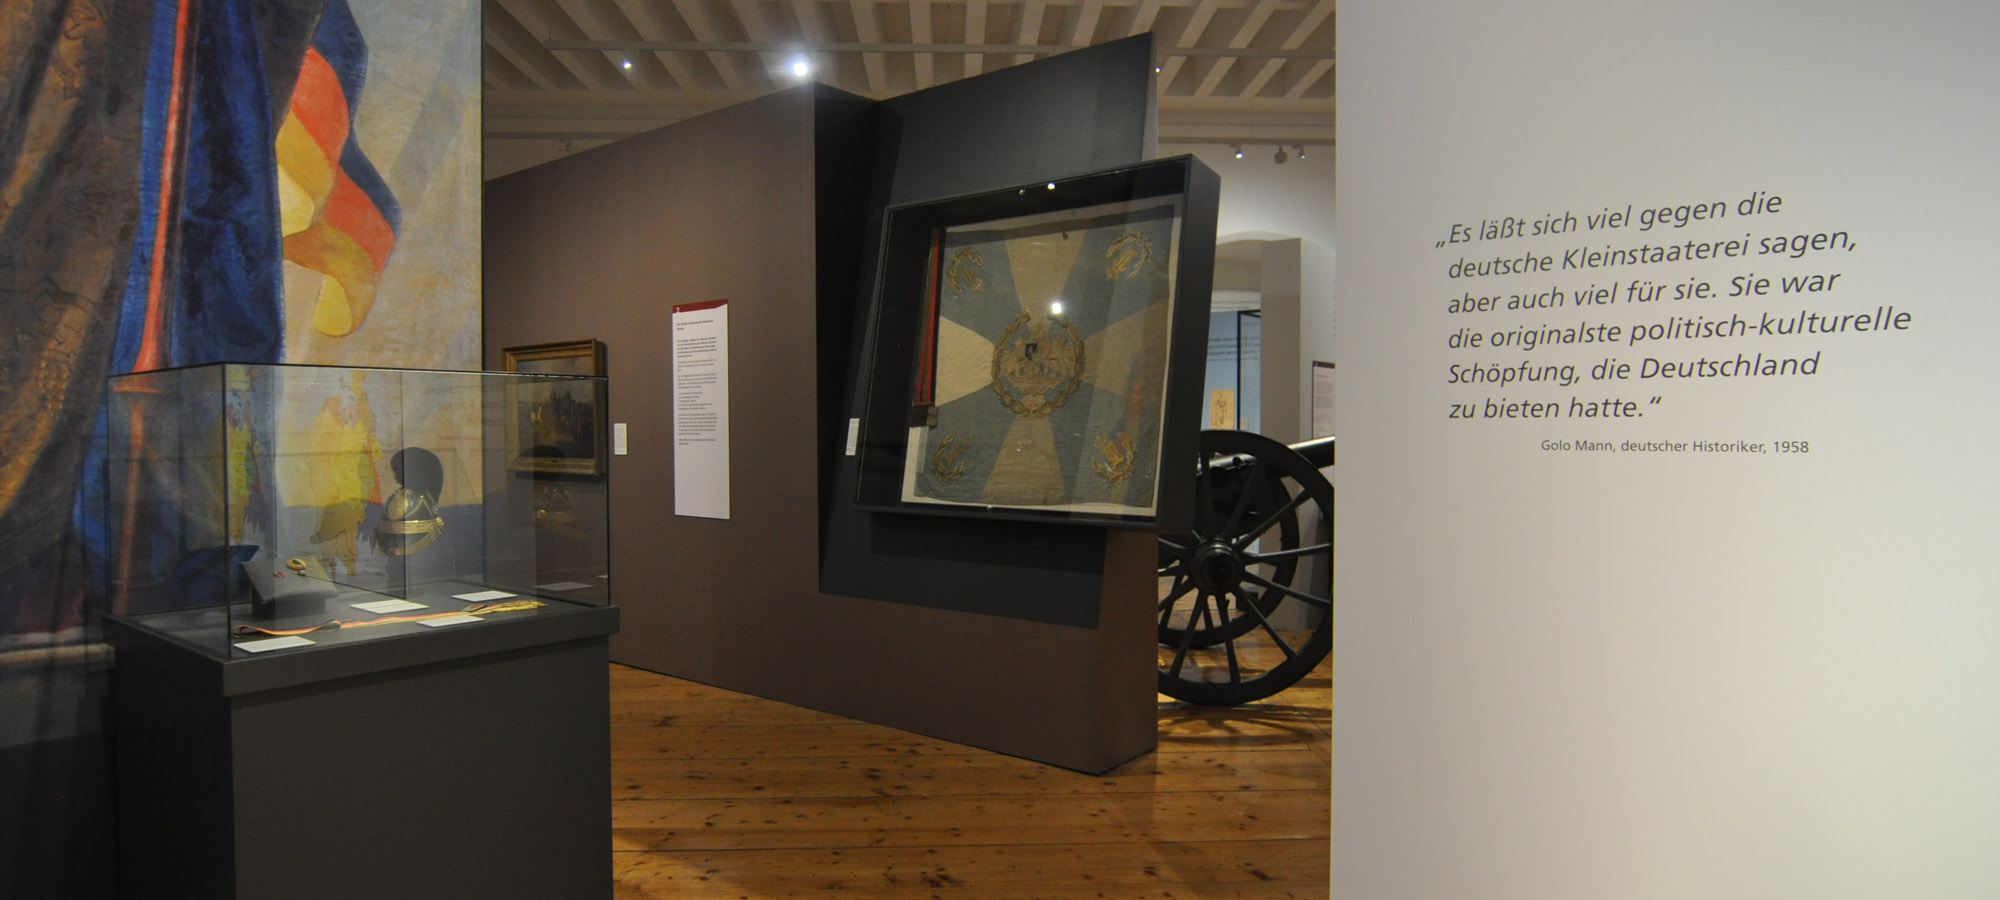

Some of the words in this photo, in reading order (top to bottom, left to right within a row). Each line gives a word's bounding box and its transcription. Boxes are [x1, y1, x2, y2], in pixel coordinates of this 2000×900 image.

[1479, 216, 1527, 241] läßt
[1531, 210, 1578, 237] sich
[1586, 204, 1632, 231] viel
[1639, 201, 1727, 232] gegen
[1737, 190, 1783, 217] die
[1448, 251, 1554, 279] deutsche
[1561, 232, 1752, 271] Kleinstaaterei
[1757, 231, 1857, 259] sagen,
[1447, 291, 1502, 314] aber
[1506, 285, 1565, 311] auch
[1574, 281, 1619, 307] viel
[1626, 279, 1668, 304] für
[1672, 276, 1717, 301] sie.
[1728, 272, 1771, 298] Sie
[1781, 273, 1842, 294] war
[1448, 327, 1483, 350] die
[1490, 320, 1622, 352] originalste
[1628, 305, 1912, 348] politisch-kulturelle
[1447, 360, 1581, 389] Schöpfung,
[1591, 357, 1631, 381] die
[1639, 350, 1822, 380] Deutschland
[1448, 403, 1477, 419] zu
[1483, 397, 1560, 419] bieten
[1540, 439, 1572, 452] Golo
[1575, 439, 1617, 454] Mann,
[1620, 439, 1689, 453] deutscher
[1692, 439, 1767, 455] Historiker,
[1773, 440, 1810, 454] 1958
